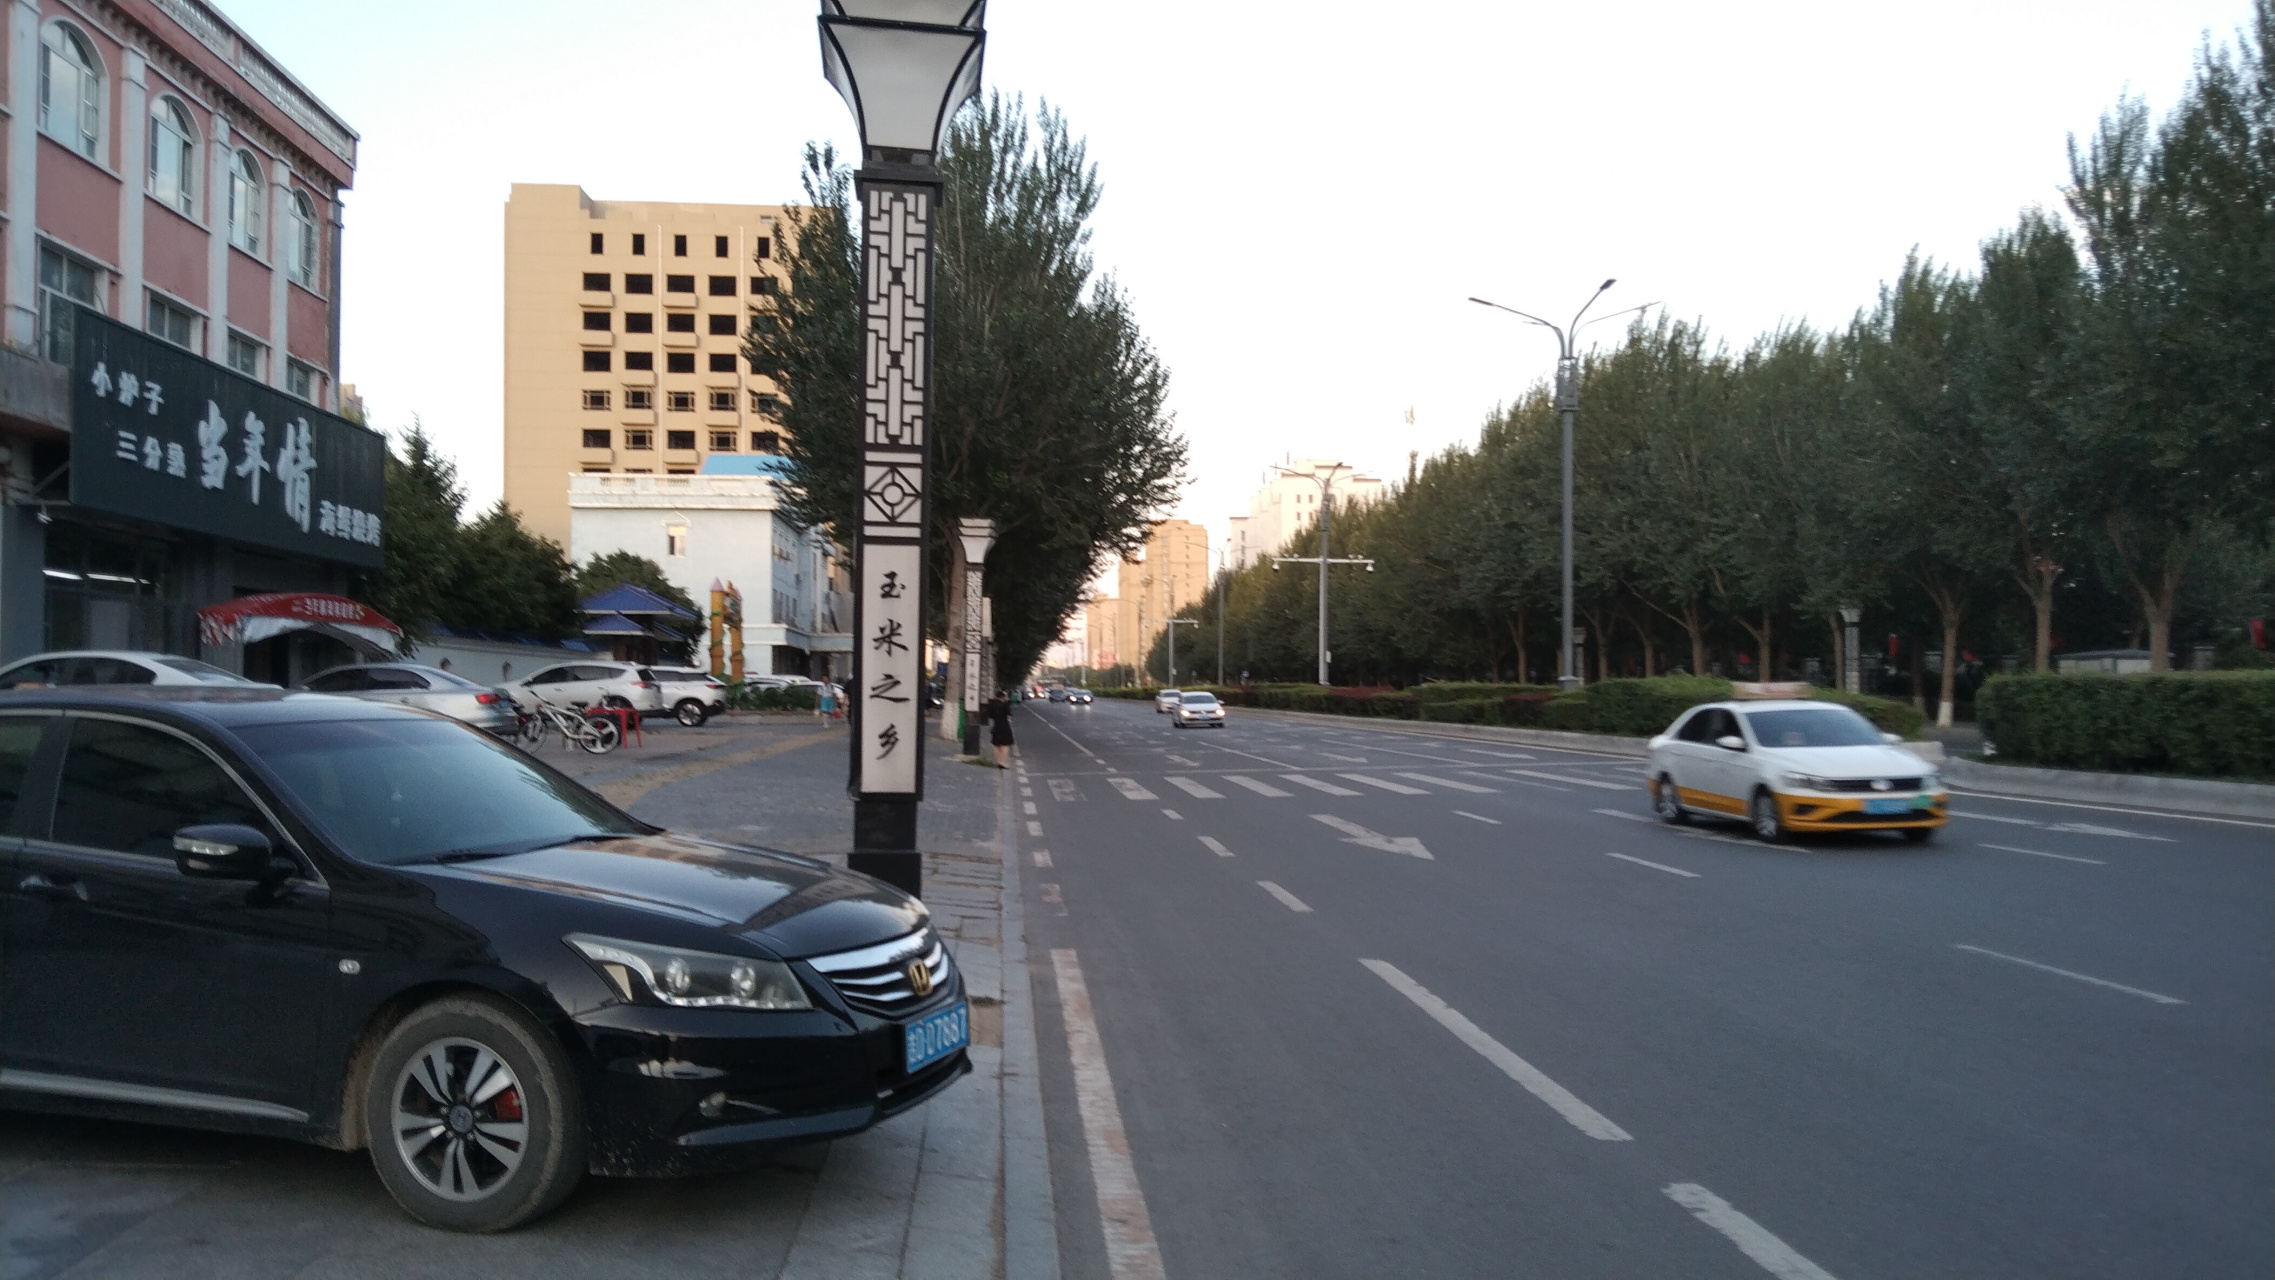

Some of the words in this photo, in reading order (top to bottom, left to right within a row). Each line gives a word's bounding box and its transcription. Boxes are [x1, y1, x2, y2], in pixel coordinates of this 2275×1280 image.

[198, 399, 318, 534] 当年情
[870, 571, 910, 760] 玉米之乡
